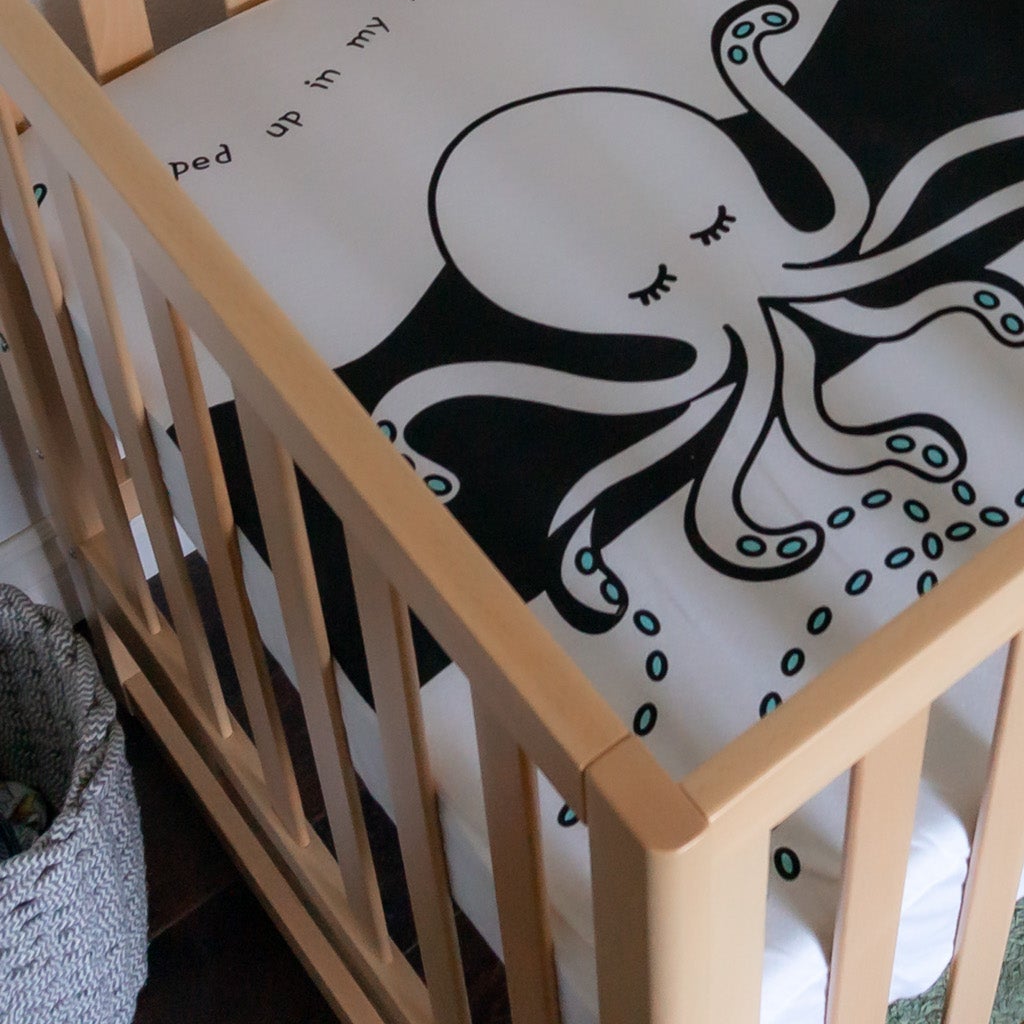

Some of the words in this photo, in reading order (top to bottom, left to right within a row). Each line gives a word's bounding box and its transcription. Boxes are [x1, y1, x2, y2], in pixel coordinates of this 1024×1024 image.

[265, 110, 304, 138] up
[303, 69, 341, 90] in
[346, 16, 390, 49] my
